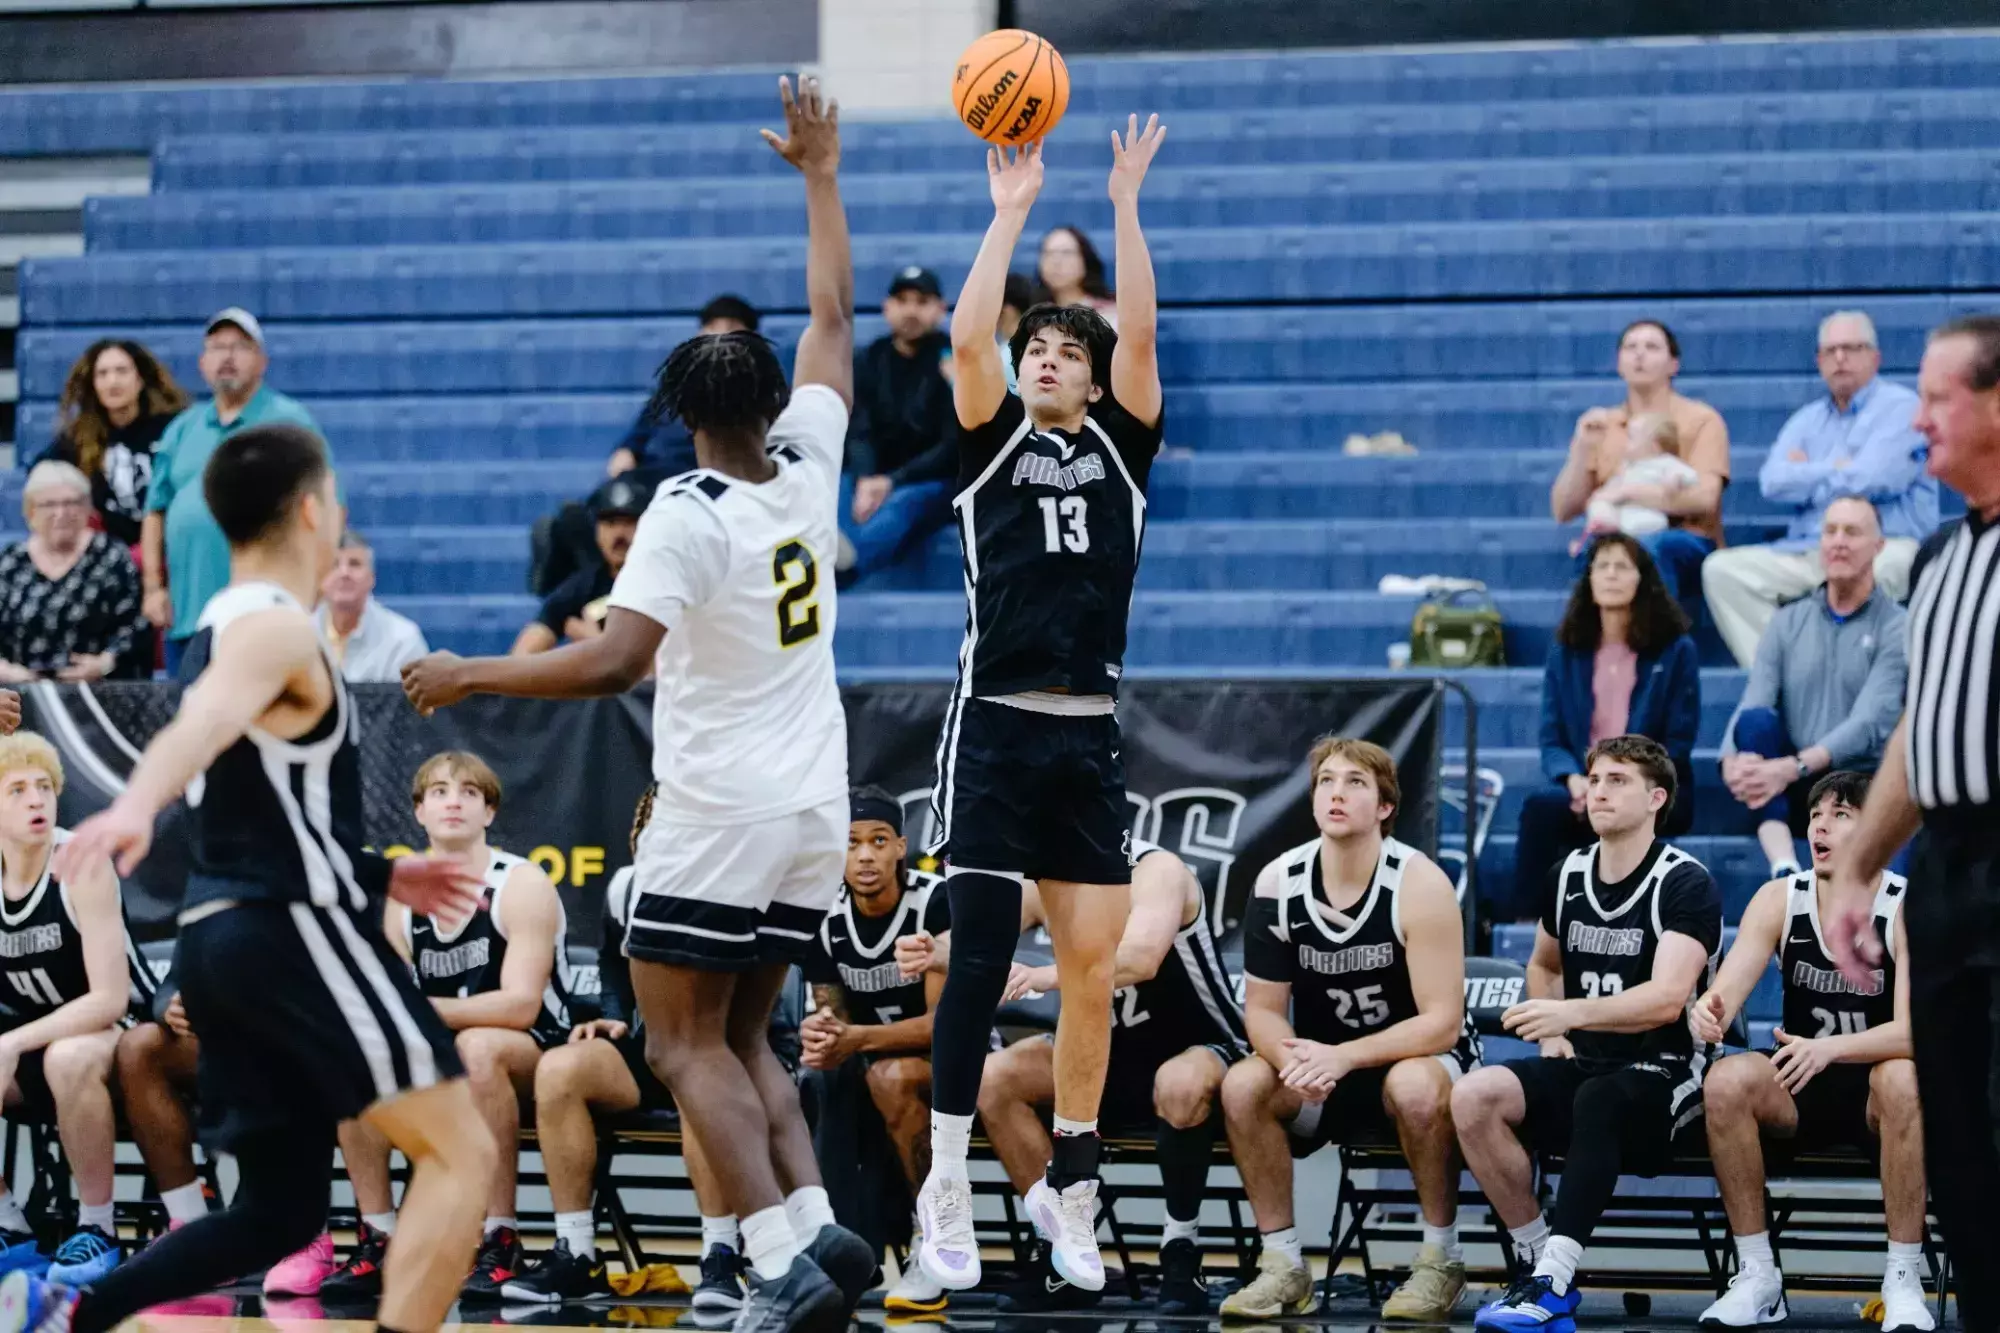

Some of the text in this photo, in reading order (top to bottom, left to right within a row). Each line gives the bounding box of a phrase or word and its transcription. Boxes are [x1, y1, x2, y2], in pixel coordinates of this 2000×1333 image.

[966, 70, 1018, 131] Wilson
[1003, 96, 1042, 140] NCAA
[1038, 496, 1090, 554] 13
[773, 537, 820, 650] 2
[528, 845, 605, 887] OF
[0, 922, 63, 958] RATES
[1299, 942, 1394, 975] PIRATES
[1568, 920, 1644, 956] PIRATES
[6, 967, 64, 1005] 41
[1326, 984, 1390, 1028] 25
[1464, 977, 1525, 1008] TES
